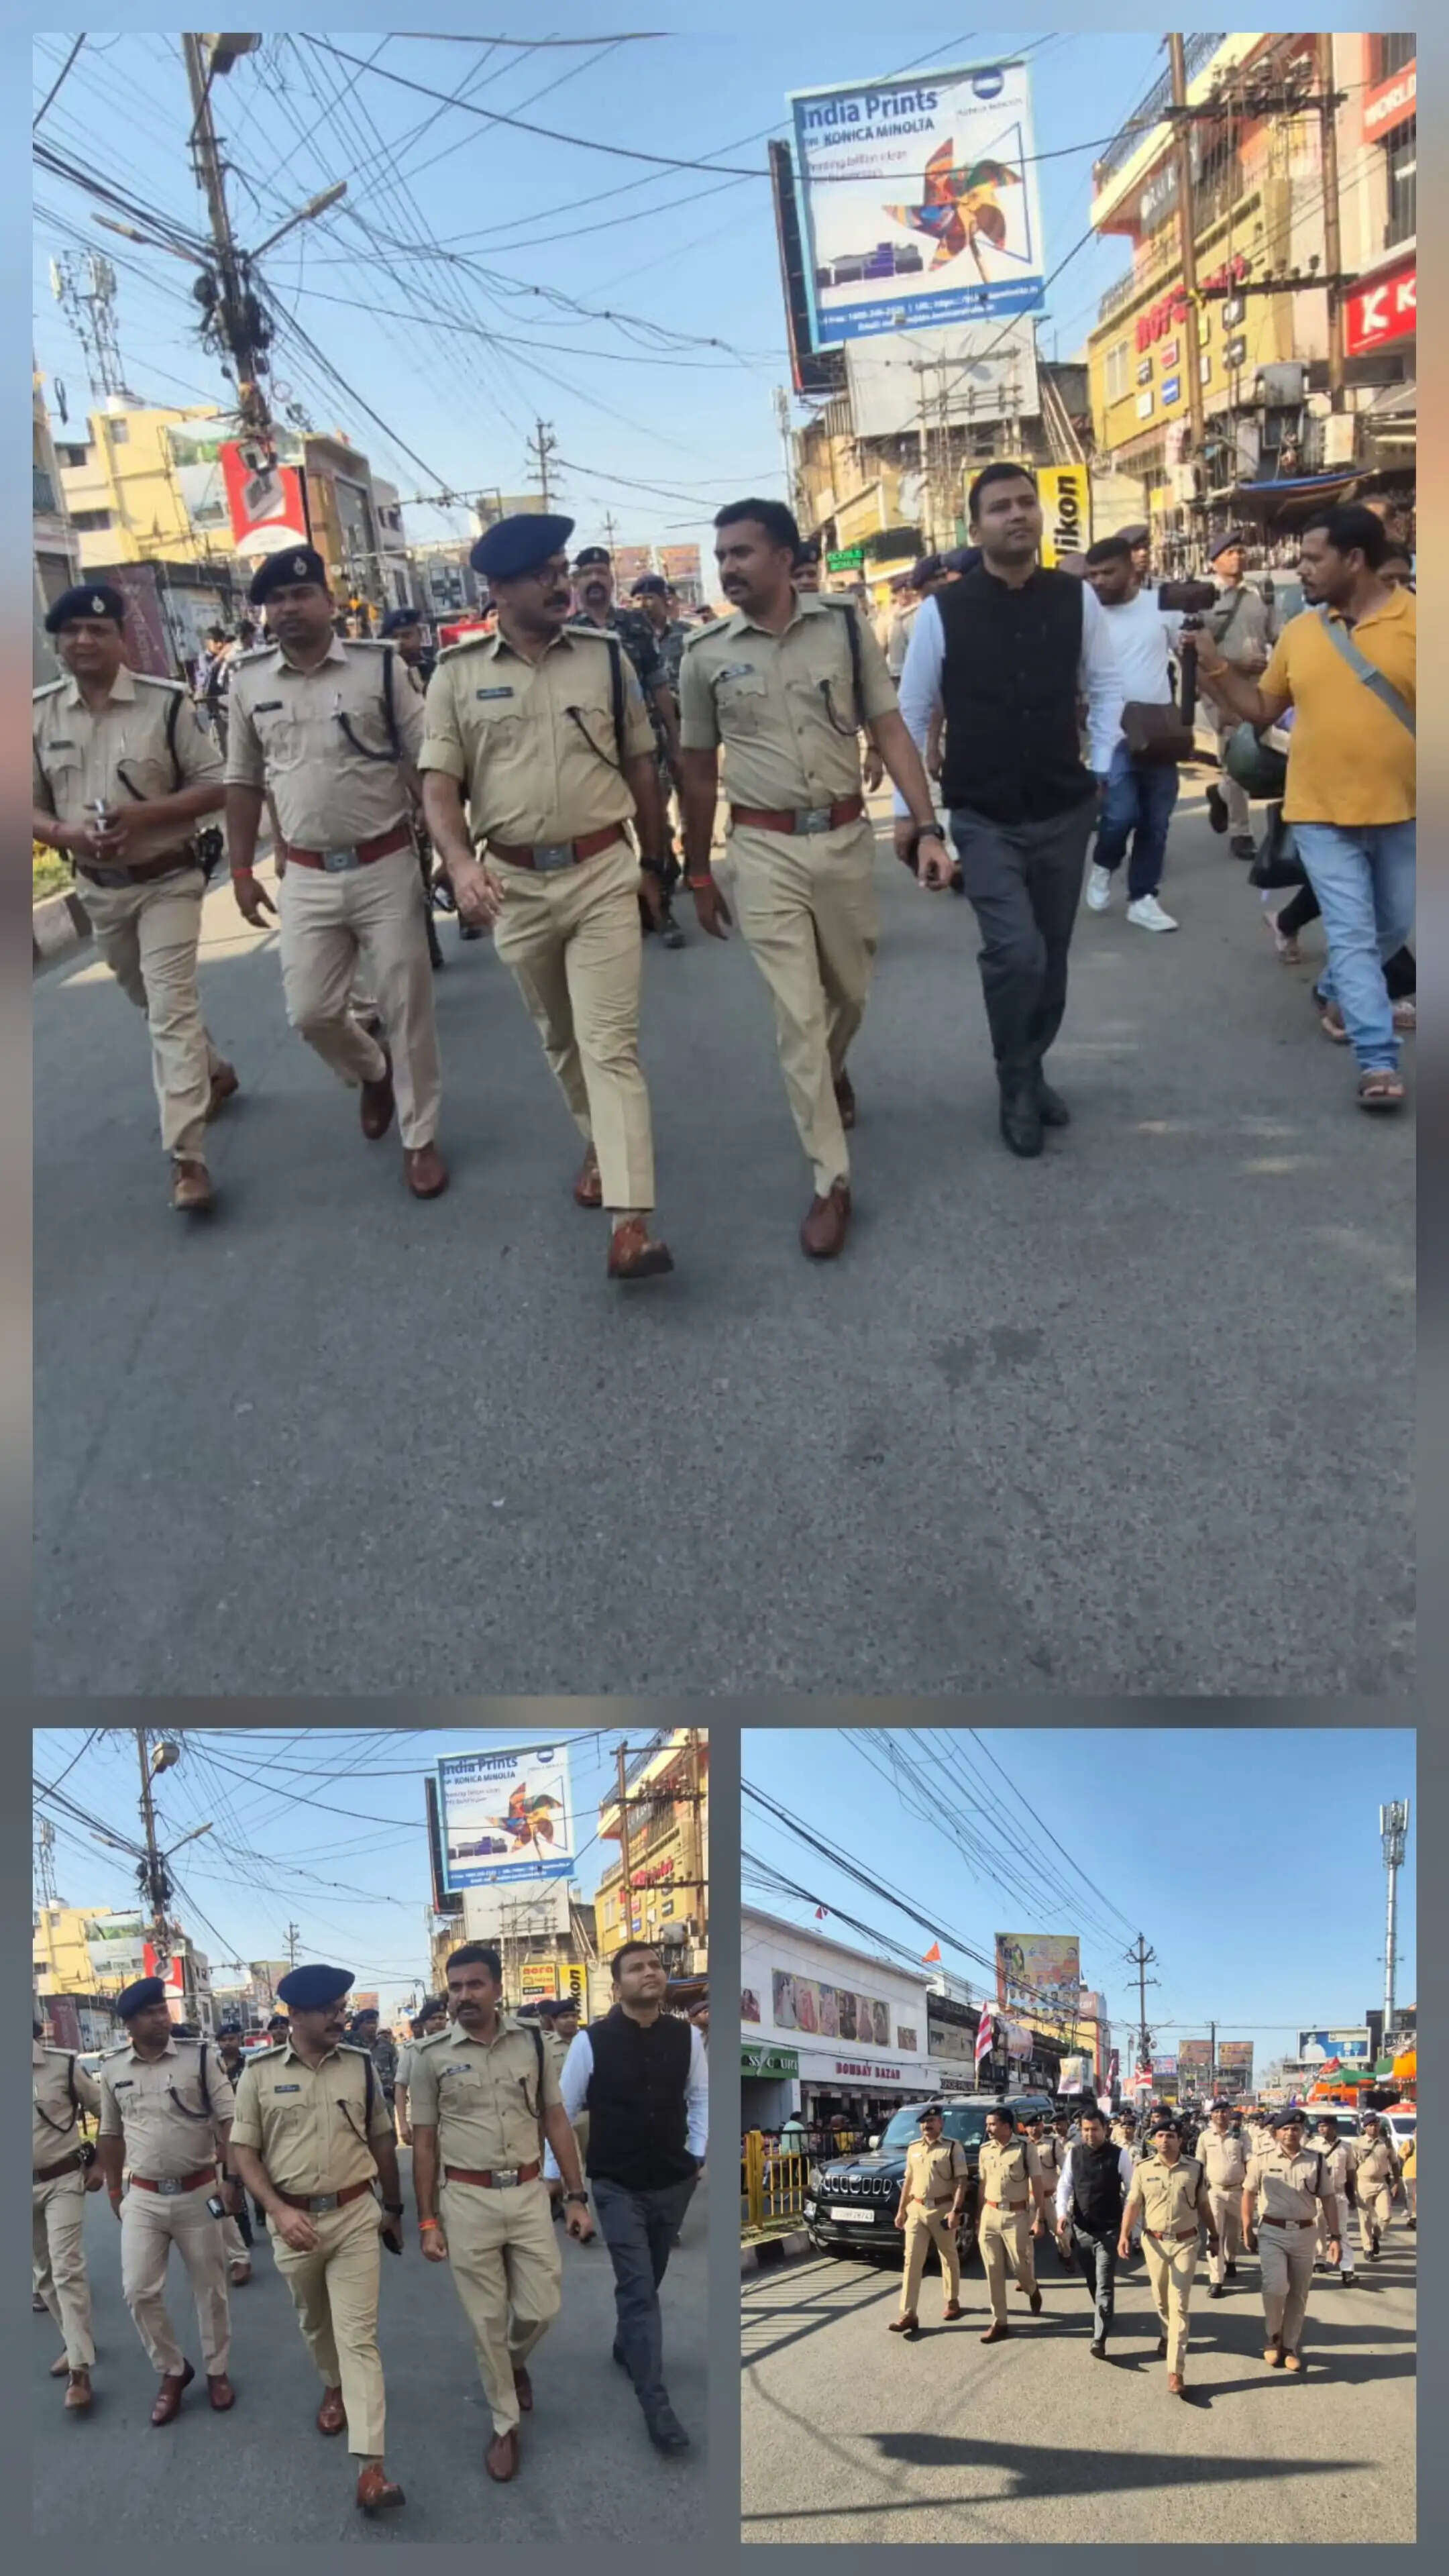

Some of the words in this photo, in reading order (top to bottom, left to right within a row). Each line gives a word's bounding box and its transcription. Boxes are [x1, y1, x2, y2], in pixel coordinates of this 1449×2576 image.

[802, 99, 861, 130] India
[865, 89, 938, 119] Prints
[824, 126, 874, 146] KONICA
[876, 117, 934, 138] MINOLTA
[1053, 476, 1079, 568] ikon
[478, 1756, 518, 1772] Prints
[455, 1775, 482, 1785] KONICA
[484, 1771, 516, 1781] MINOLTA
[836, 2062, 871, 2077] BOMBAY
[875, 2066, 900, 2080] BAZAR
